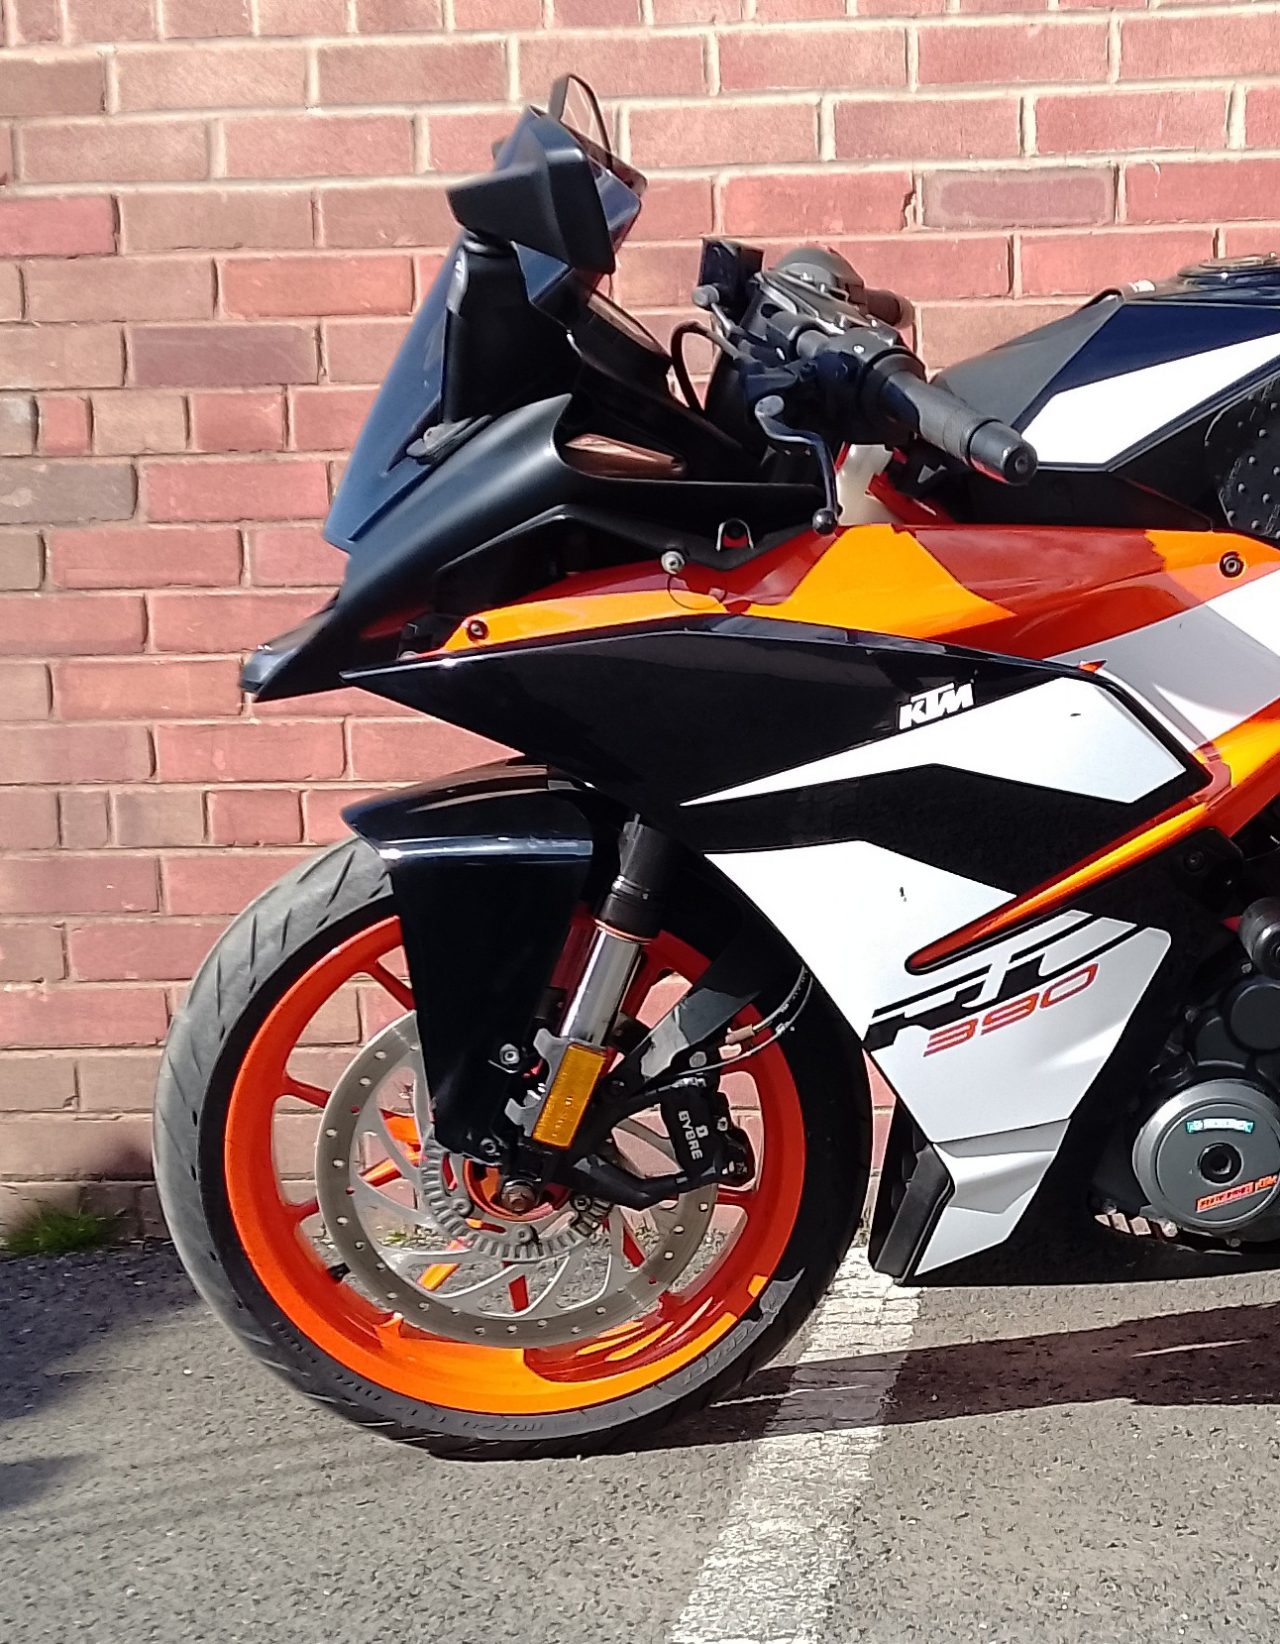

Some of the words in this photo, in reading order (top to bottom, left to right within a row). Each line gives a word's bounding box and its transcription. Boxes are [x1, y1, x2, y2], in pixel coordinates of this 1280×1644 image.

[899, 682, 975, 730] KTM
[923, 963, 1099, 1057] 390
[678, 1110, 703, 1160] BYBRE
